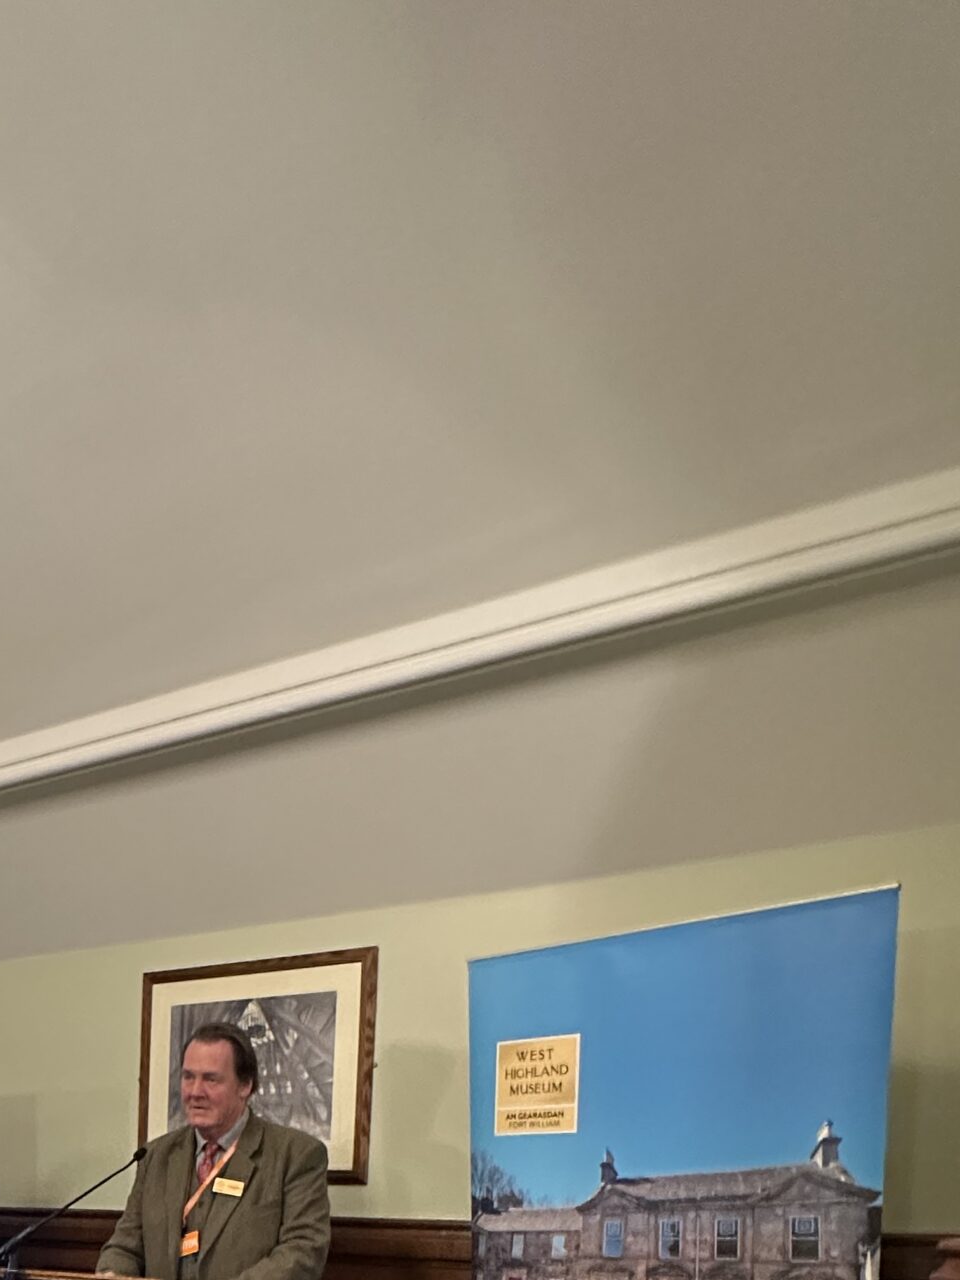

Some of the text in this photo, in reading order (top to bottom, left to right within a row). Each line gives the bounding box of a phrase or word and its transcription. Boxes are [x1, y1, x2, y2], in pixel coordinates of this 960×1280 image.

[516, 1048, 554, 1062] WEST
[505, 1064, 569, 1080] HIGHLAND
[509, 1081, 562, 1096] MUSEUM
